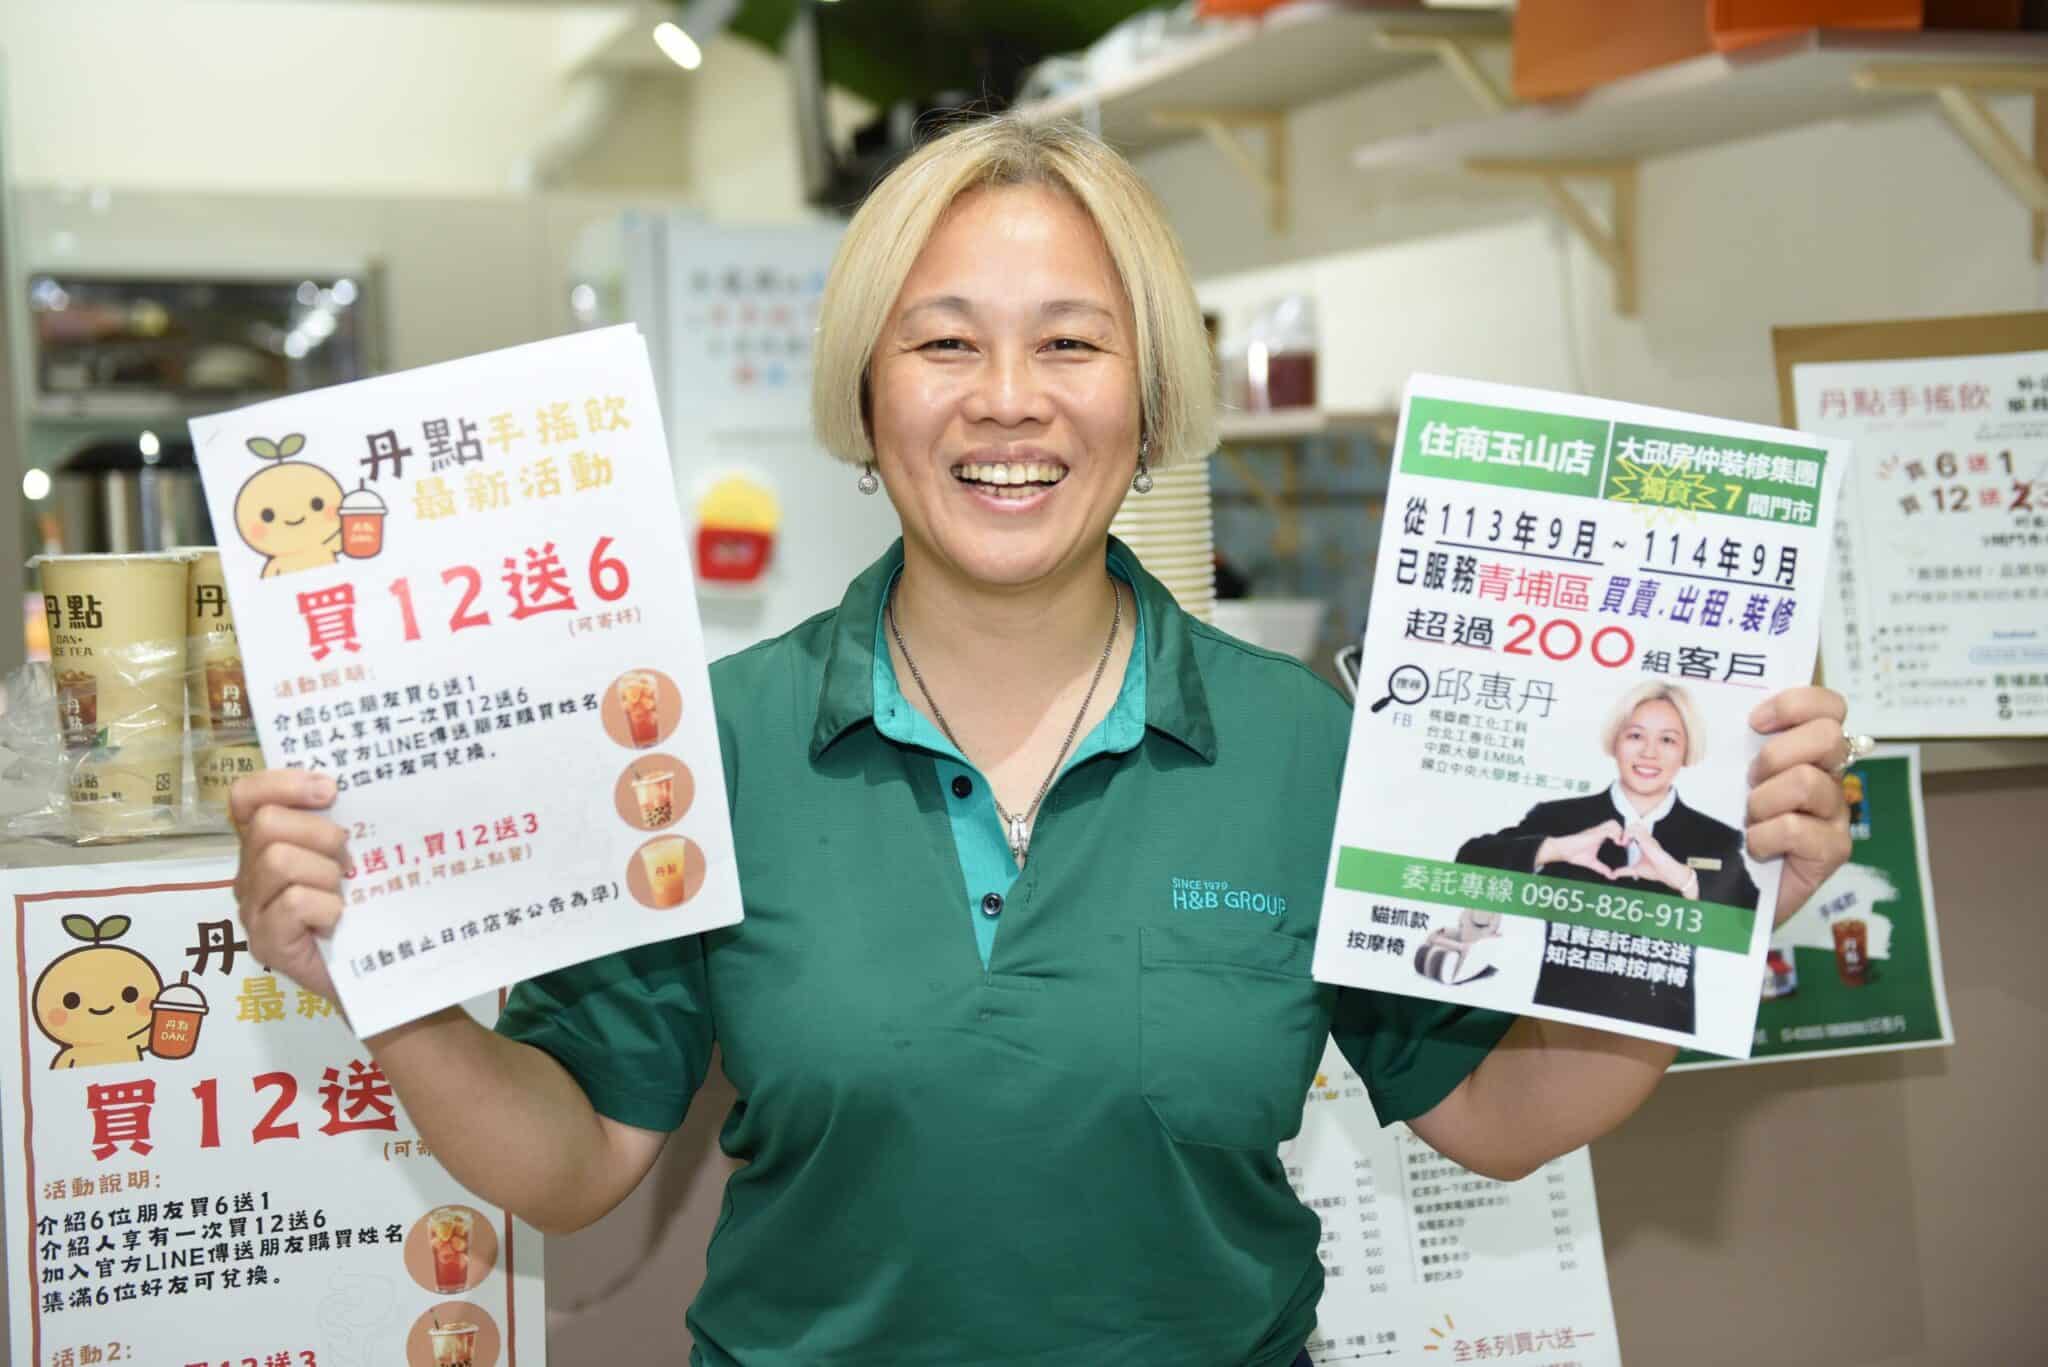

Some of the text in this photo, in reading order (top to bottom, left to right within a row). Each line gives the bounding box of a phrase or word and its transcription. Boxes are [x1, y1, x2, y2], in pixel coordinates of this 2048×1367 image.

[360, 395, 633, 482] 丹點手搖飲
[1419, 421, 1596, 476] 住商玉山店
[1616, 435, 1820, 489] 大邱房仲裝修集團
[411, 450, 615, 521] 最新活動
[1723, 484, 1744, 511] 7
[1746, 492, 1814, 523] 間門市
[296, 536, 631, 662] 買12送6
[1397, 548, 1594, 613] 已服務青埔區
[274, 674, 477, 733] 介紹6位朋友買6送1
[1432, 667, 1560, 718] 邱惠丹
[281, 687, 530, 754] 介紹人享有一次買12送6
[1172, 877, 1202, 890] SINCE
[1173, 889, 1287, 916] H&B GROUP
[1401, 864, 1704, 933] 委託專線 0965-826-913
[1347, 930, 1406, 957] 按摩椅
[1370, 905, 1431, 931] 貓抓款
[186, 919, 249, 976] 丹
[1545, 945, 1689, 988] 知名品牌按摩椅
[44, 1170, 162, 1201] 活動說明:
[37, 1191, 271, 1237] 介紹6位朋友買6送1
[40, 1208, 327, 1262] 介紹人享有一次買12送6
[42, 1223, 403, 1284] 加入官方LINE傳送朋友購買姓名
[1453, 1327, 1596, 1362] 全系列買六送一
